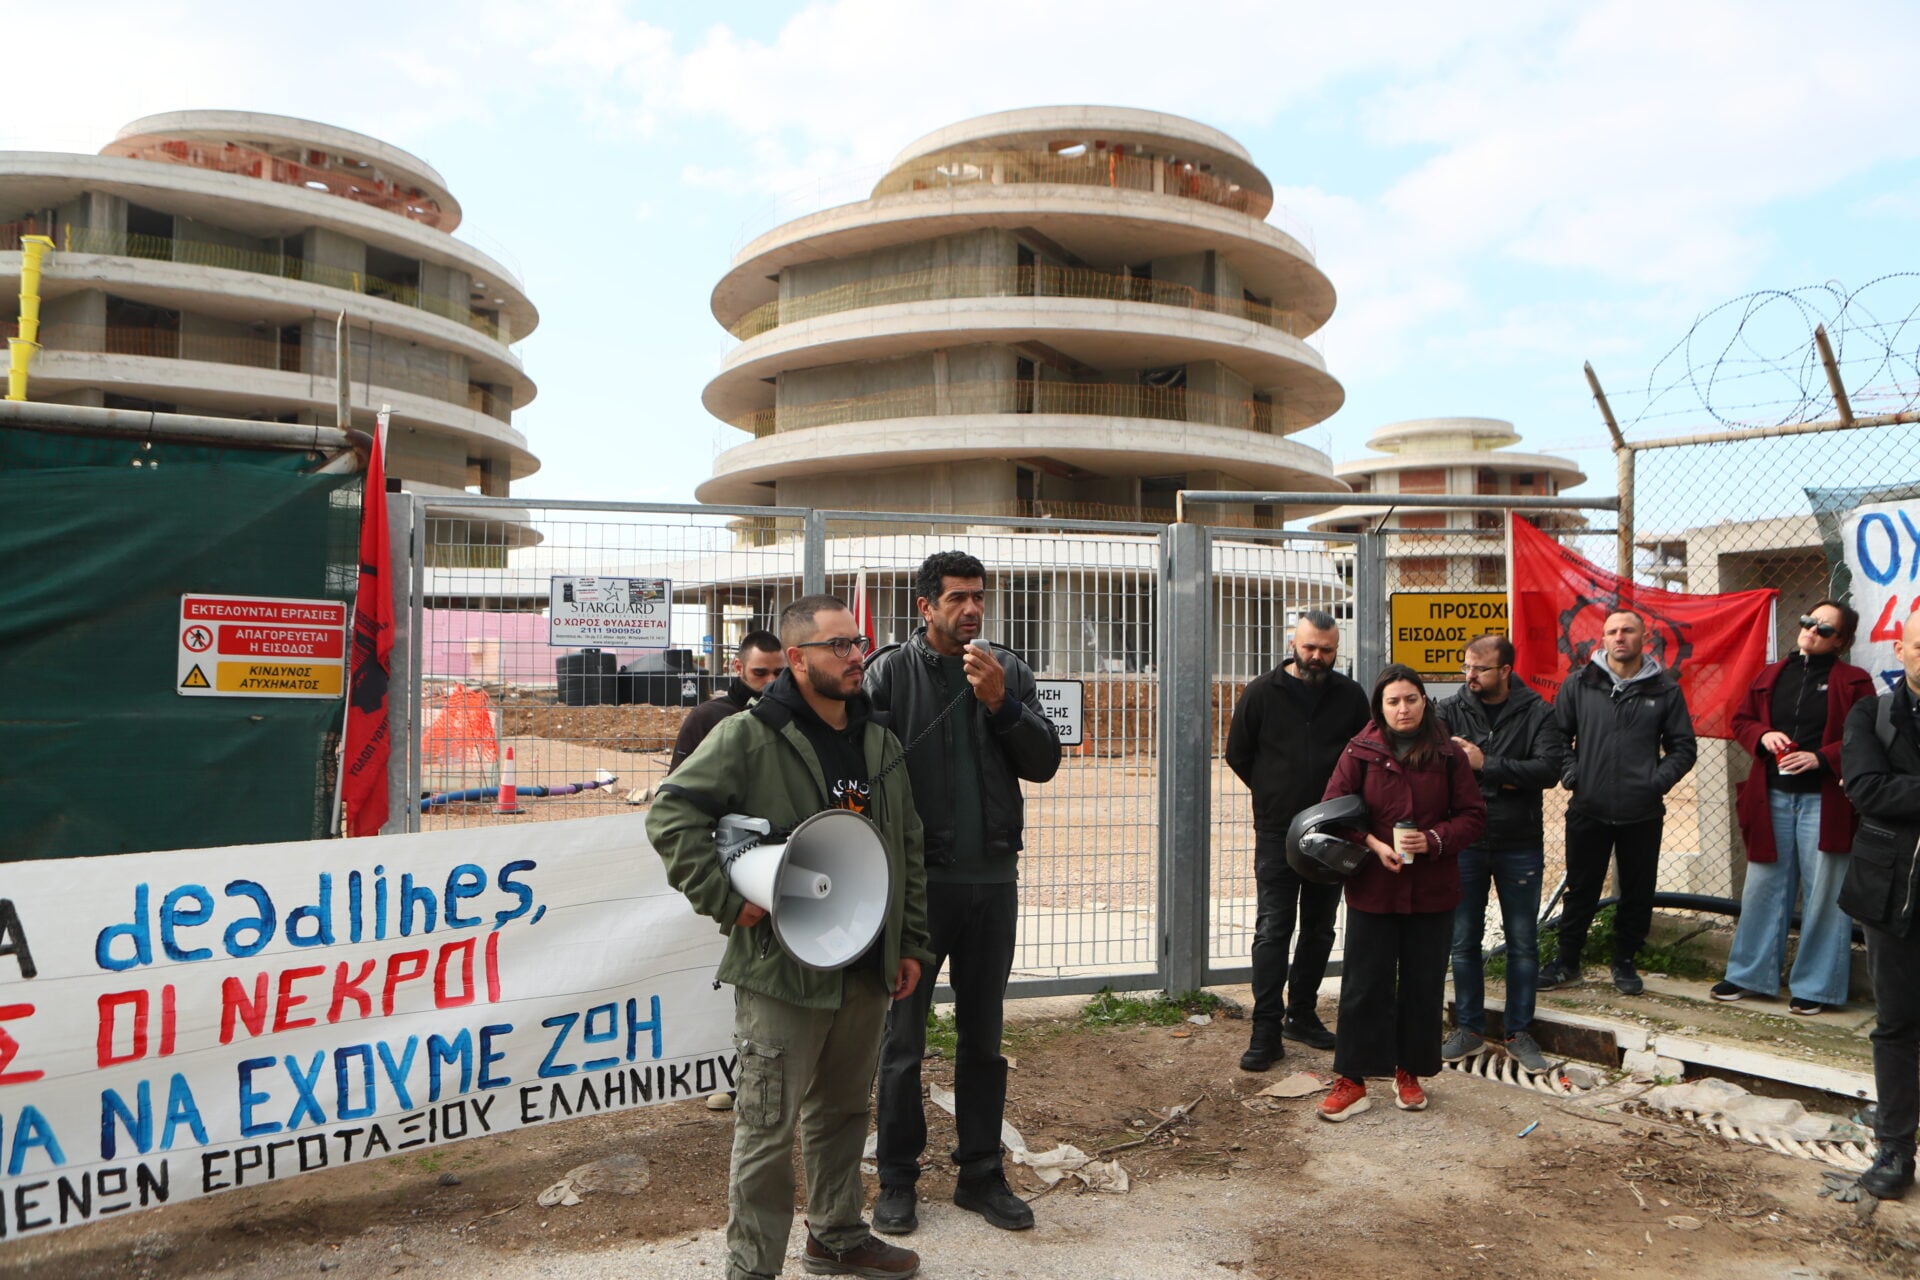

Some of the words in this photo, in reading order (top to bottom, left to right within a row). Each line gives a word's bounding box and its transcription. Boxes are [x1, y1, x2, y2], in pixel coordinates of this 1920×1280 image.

[191, 604, 278, 618] ΕΚΤΕΛΟΥΝΤΑΙ
[281, 608, 337, 620] ΕΡΓΑΣΙΕΣ
[571, 601, 655, 615] STARGUARD
[553, 618, 561, 626] Ο
[564, 618, 600, 627] ΧΩΡΟΣ
[603, 619, 667, 628] ΦΥΛΑΣΣΕΤΑΙ
[235, 629, 328, 642] ΑΠΑΓΟΡΕΥΕΤΑΙ
[606, 627, 641, 635] 900950
[1398, 627, 1467, 642] ΕΙΣΟΔΟΣ
[250, 643, 259, 653] Η
[262, 644, 314, 654] ΕΙΣΟΔΟΣ
[249, 665, 312, 677] ΚΙΝΔΥΝΟΣ
[239, 678, 320, 690] ΑΤΥΧΗΜΑΤΟΣ
[95, 859, 546, 971] deadlines,
[97, 984, 176, 1069] ΟΙ
[219, 931, 501, 1044] ΝΕΚΡΟΙ
[0, 1105, 66, 1176] Α
[101, 1072, 209, 1160] ΝΑ
[238, 1023, 513, 1138] ΕΧΟΥΜΕ
[538, 994, 662, 1078] ΖΩΗ
[0, 1159, 170, 1238] ΕΝΩΝ
[201, 1094, 495, 1193] ΕΡΓΟΤΑΞΙΟΥ
[520, 1054, 738, 1124] ΕΛΛΗΝΙΚΟΥ
